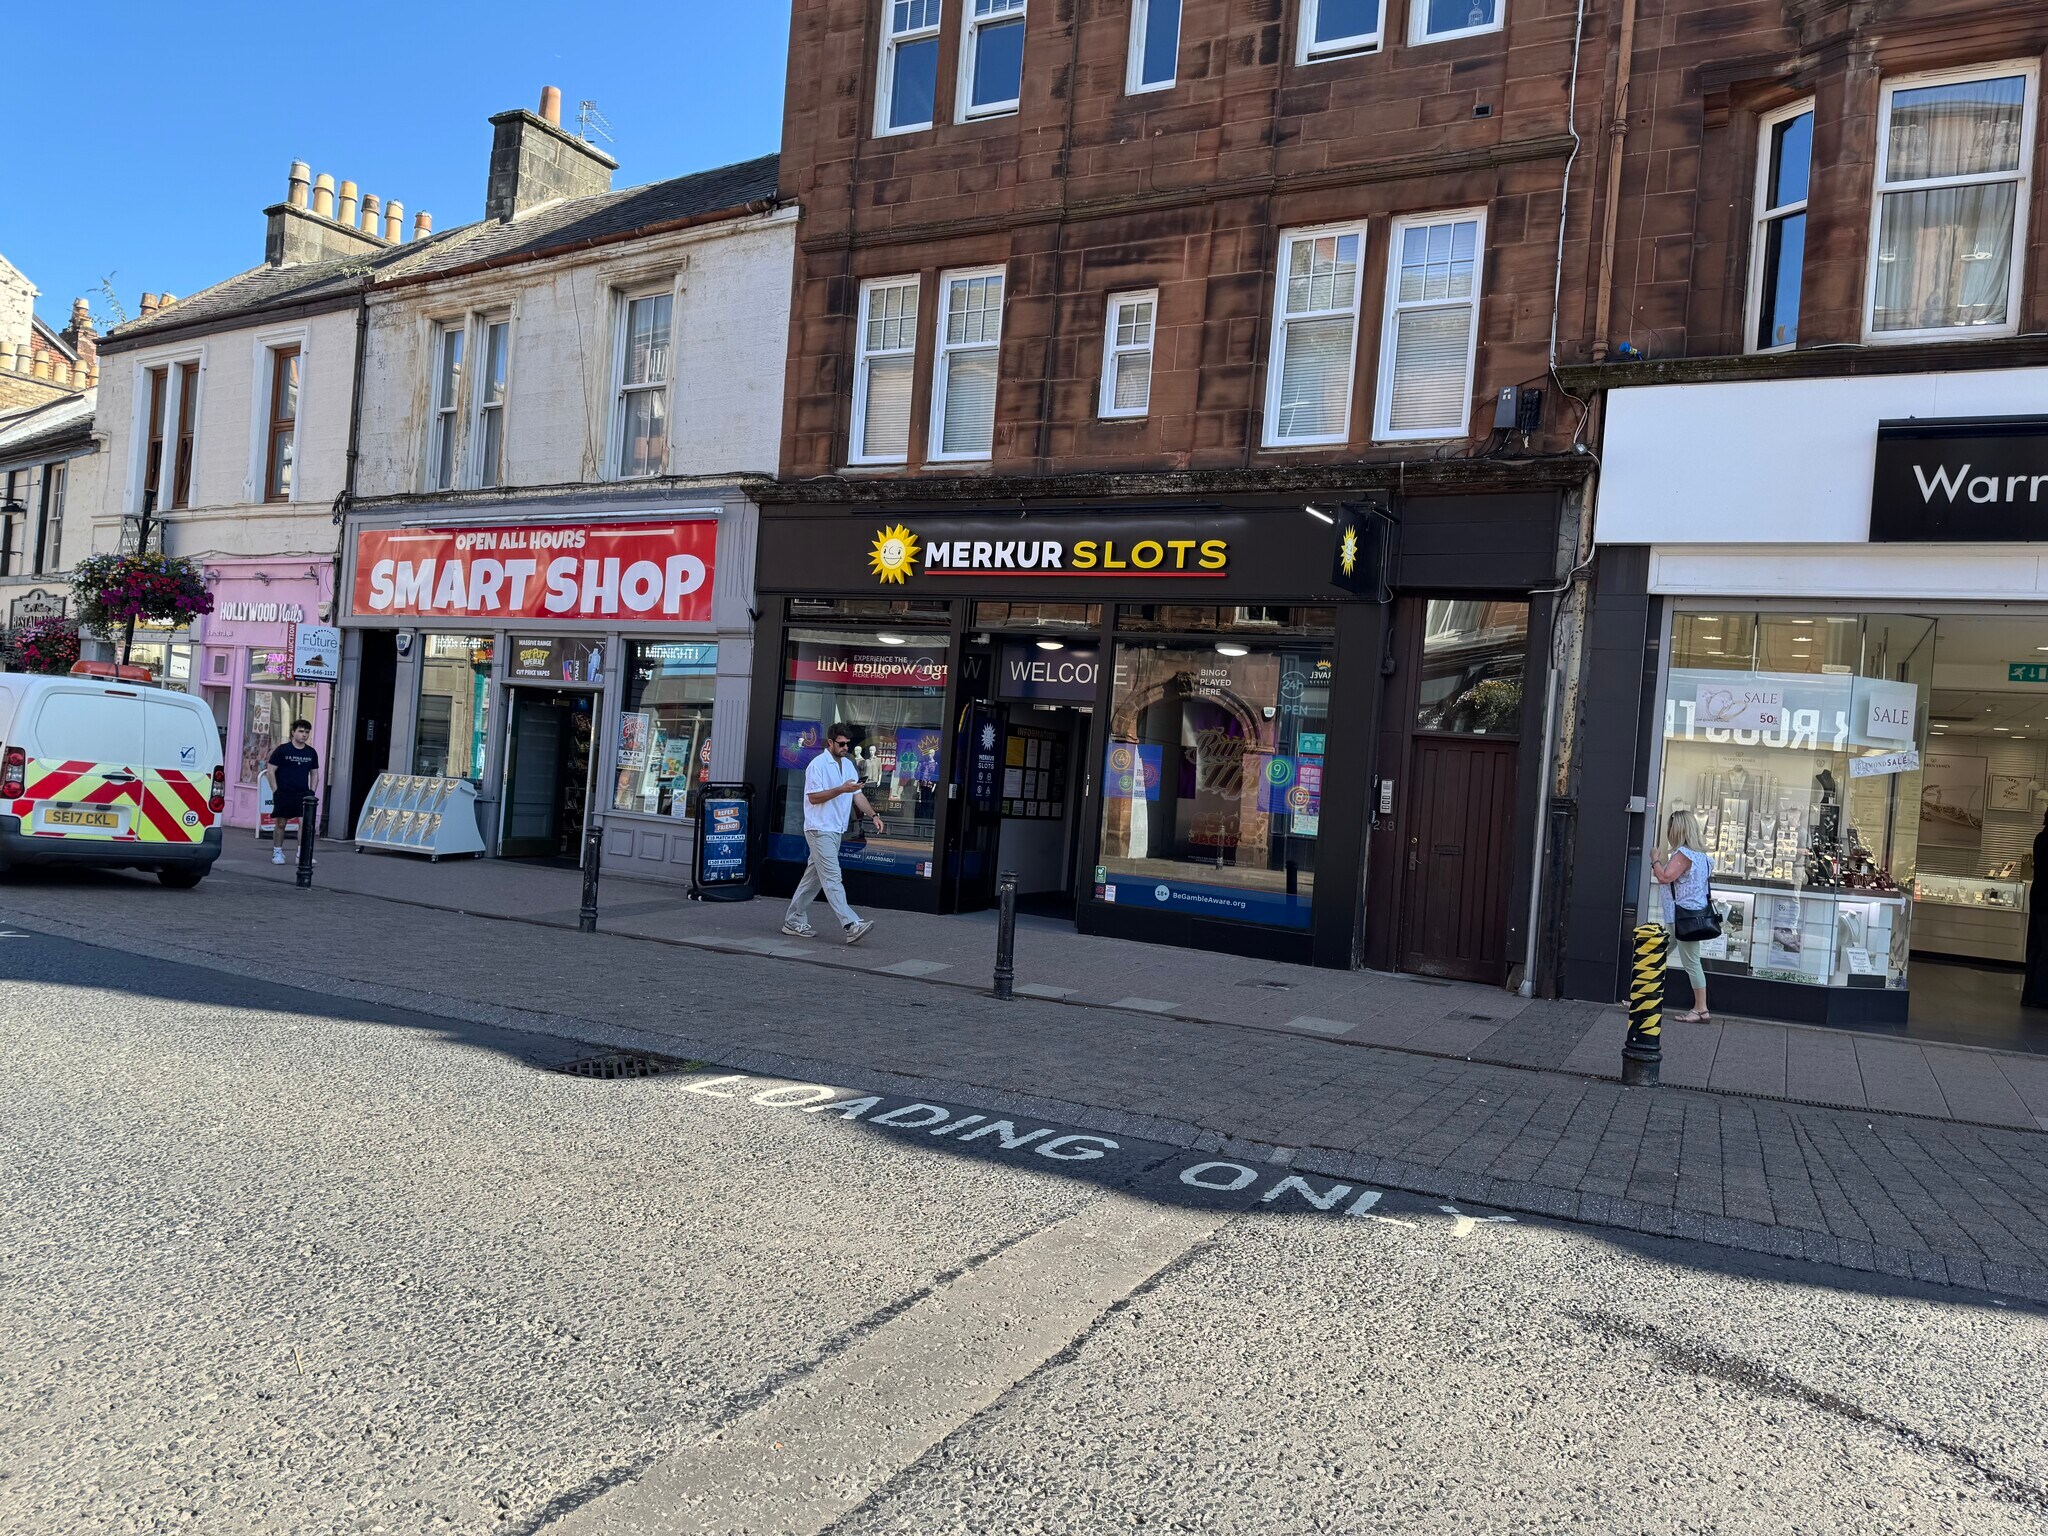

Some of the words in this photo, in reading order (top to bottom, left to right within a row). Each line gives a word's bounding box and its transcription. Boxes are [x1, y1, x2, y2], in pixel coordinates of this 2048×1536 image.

[1912, 464, 2048, 504] Warr
[455, 533, 498, 551] OPEN
[499, 531, 527, 549] ALL
[529, 529, 586, 549] HOURS
[924, 541, 1063, 568] MERKUR
[1071, 540, 1229, 569] SLOTS
[368, 557, 537, 612] SMART
[544, 554, 707, 615] SHOP
[220, 601, 277, 621] HOLLYWOOD
[278, 603, 304, 623] Nails
[302, 633, 338, 649] Future
[288, 654, 294, 662] by
[645, 646, 694, 659] MIDNIGHT
[853, 654, 893, 662] EXPERIENCE
[894, 656, 908, 664] THE
[1200, 668, 1227, 677] BINGO
[1199, 678, 1232, 687] PLAYED
[1282, 679, 1304, 690] 24h
[1199, 687, 1222, 696] HERE
[1743, 691, 1778, 704] SALE
[1873, 706, 1909, 725] SALE
[1887, 756, 1908, 767] SALE
[1273, 764, 1281, 775] 9
[53, 811, 82, 823] SE17
[86, 813, 111, 826] CKL
[1156, 889, 1168, 897] 18+
[1172, 892, 1247, 909] BeGambleAware.org
[681, 1073, 1120, 1161] LOADING
[1178, 1161, 1519, 1239] ONLY
